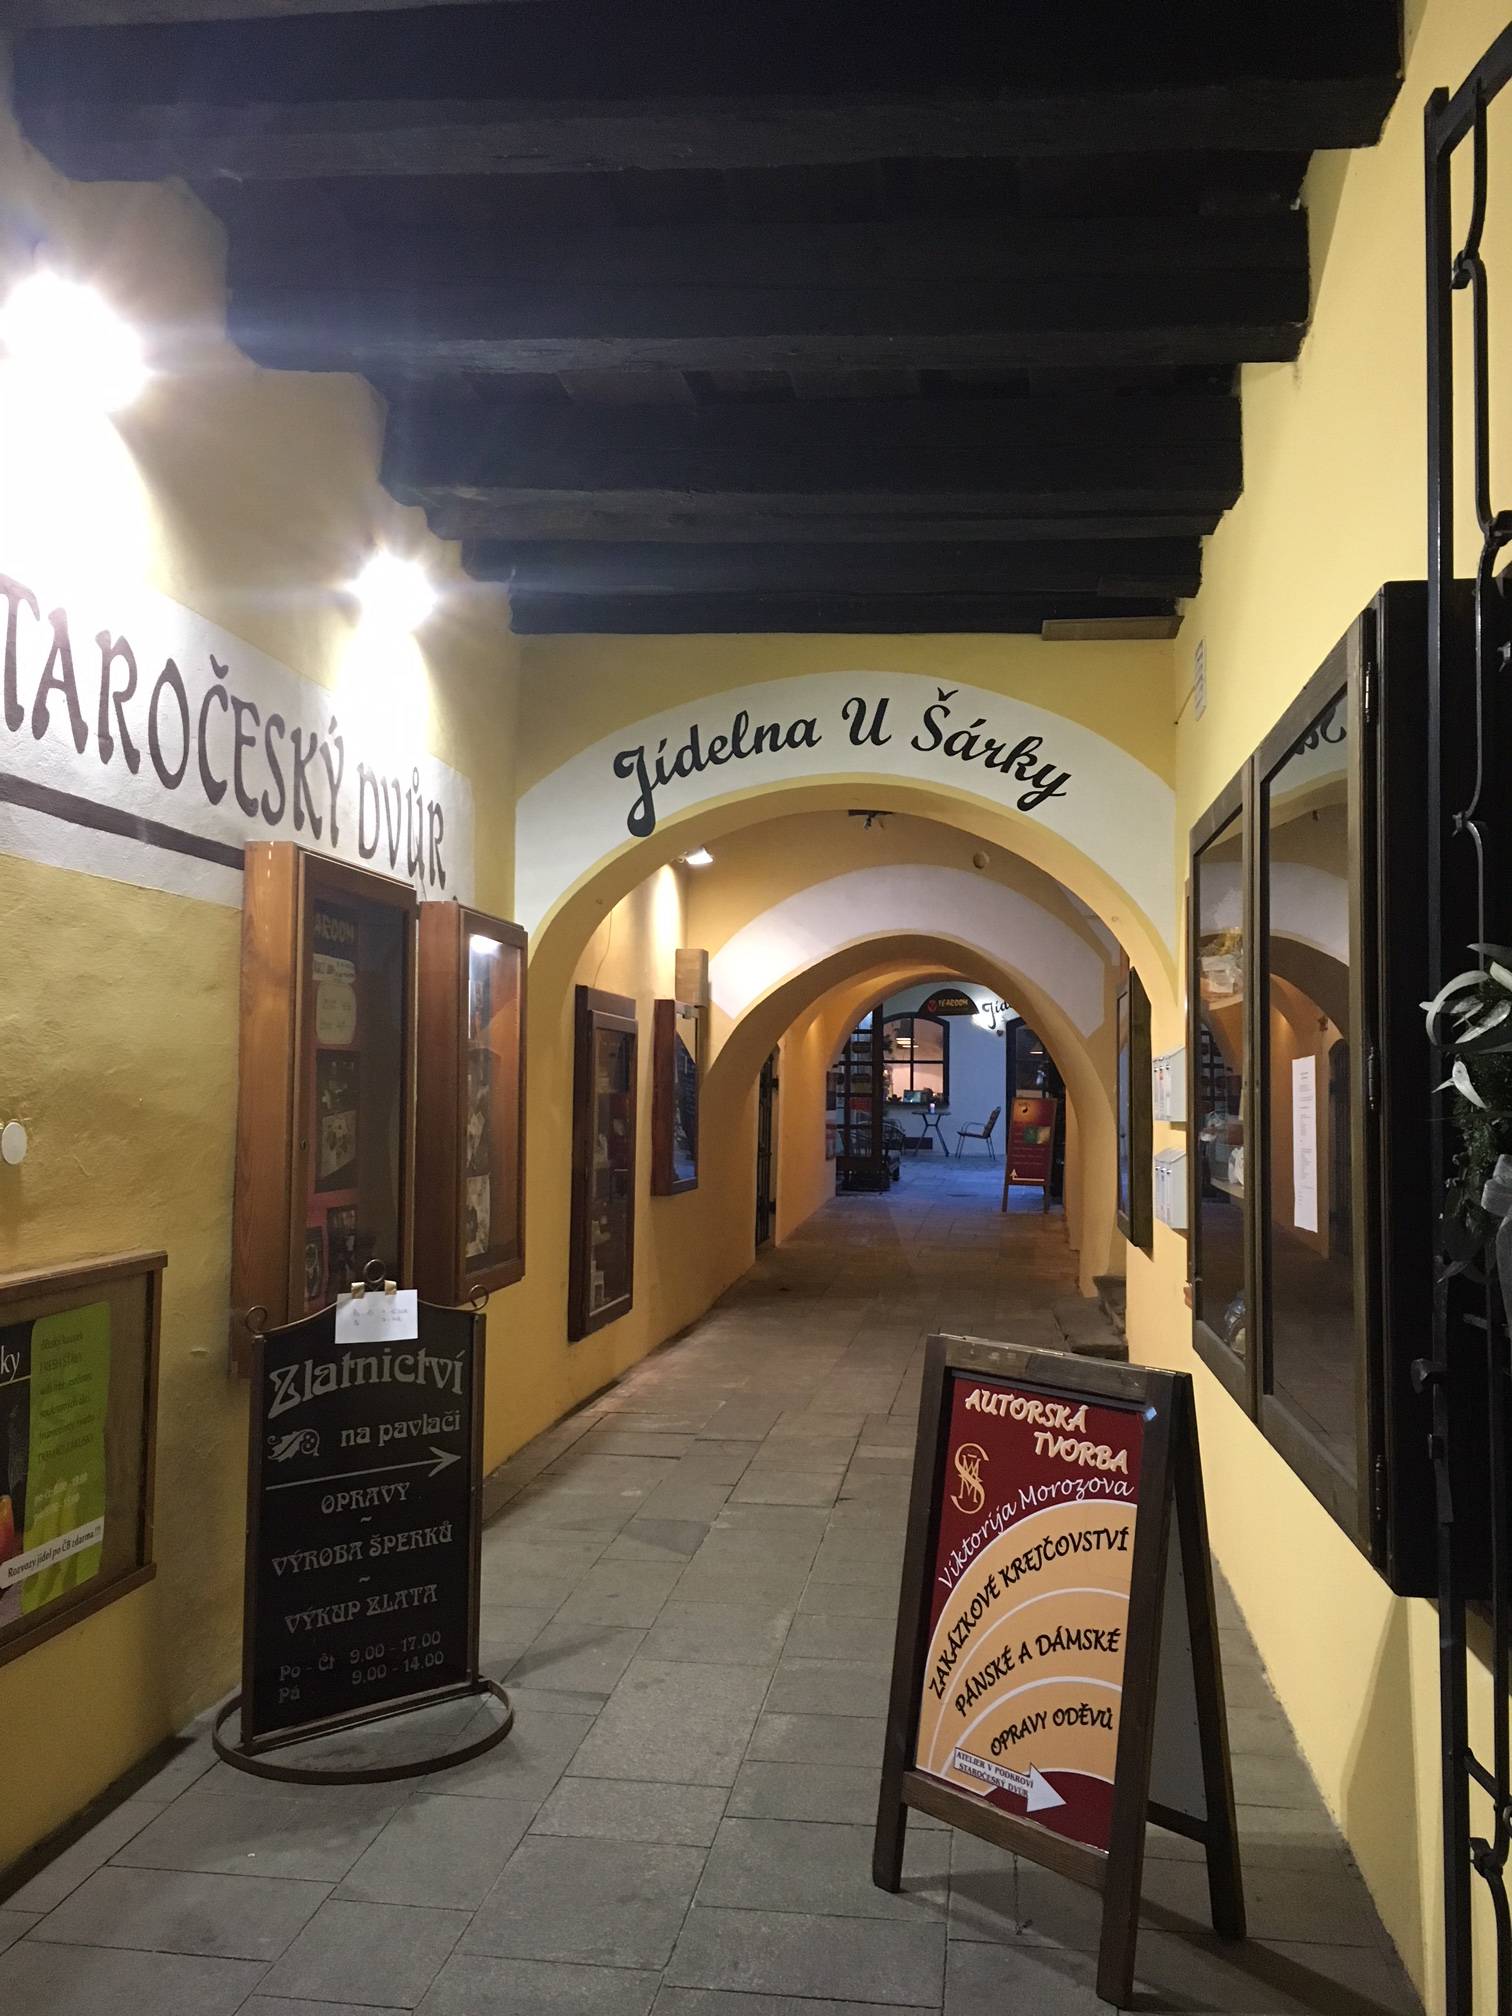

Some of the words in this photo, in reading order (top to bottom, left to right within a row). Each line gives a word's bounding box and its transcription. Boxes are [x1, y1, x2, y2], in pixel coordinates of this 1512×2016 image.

[613, 709, 823, 838] Jídelna
[842, 696, 893, 747] U
[910, 686, 1073, 812] Šárky
[268, 1347, 466, 1420] Zlatnictví
[341, 1426, 371, 1448] na
[378, 1410, 461, 1448] pavlači
[965, 1388, 1089, 1433] AUTORSKÁ
[1034, 1431, 1129, 1475] TVORBA
[320, 1482, 410, 1514] OPRAVY
[271, 1541, 363, 1576] VÝROBA
[369, 1520, 453, 1557] ŠPERKŮ
[938, 1501, 1017, 1589] Viktorija
[1018, 1476, 1135, 1510] Morozova
[284, 1600, 360, 1634] VÝKUP
[365, 1583, 439, 1616] ZLATA
[929, 1575, 1001, 1700] ZAKÁZKOVÉ
[1000, 1526, 1129, 1588] KREJČOVSTVÍ
[279, 1664, 300, 1681] Po
[350, 1643, 385, 1665] 9.00
[402, 1631, 441, 1652] 17.00
[352, 1664, 387, 1685] 9.00
[404, 1651, 445, 1672] 14.00
[954, 1645, 1015, 1717] PÁNSKÉ
[1018, 1641, 1033, 1665] A
[1035, 1625, 1121, 1657] DÁMSKÉ
[990, 1711, 1047, 1756] OPRAVY
[1052, 1703, 1113, 1730] ODĚVŮ
[956, 1751, 986, 1769] ATELIER
